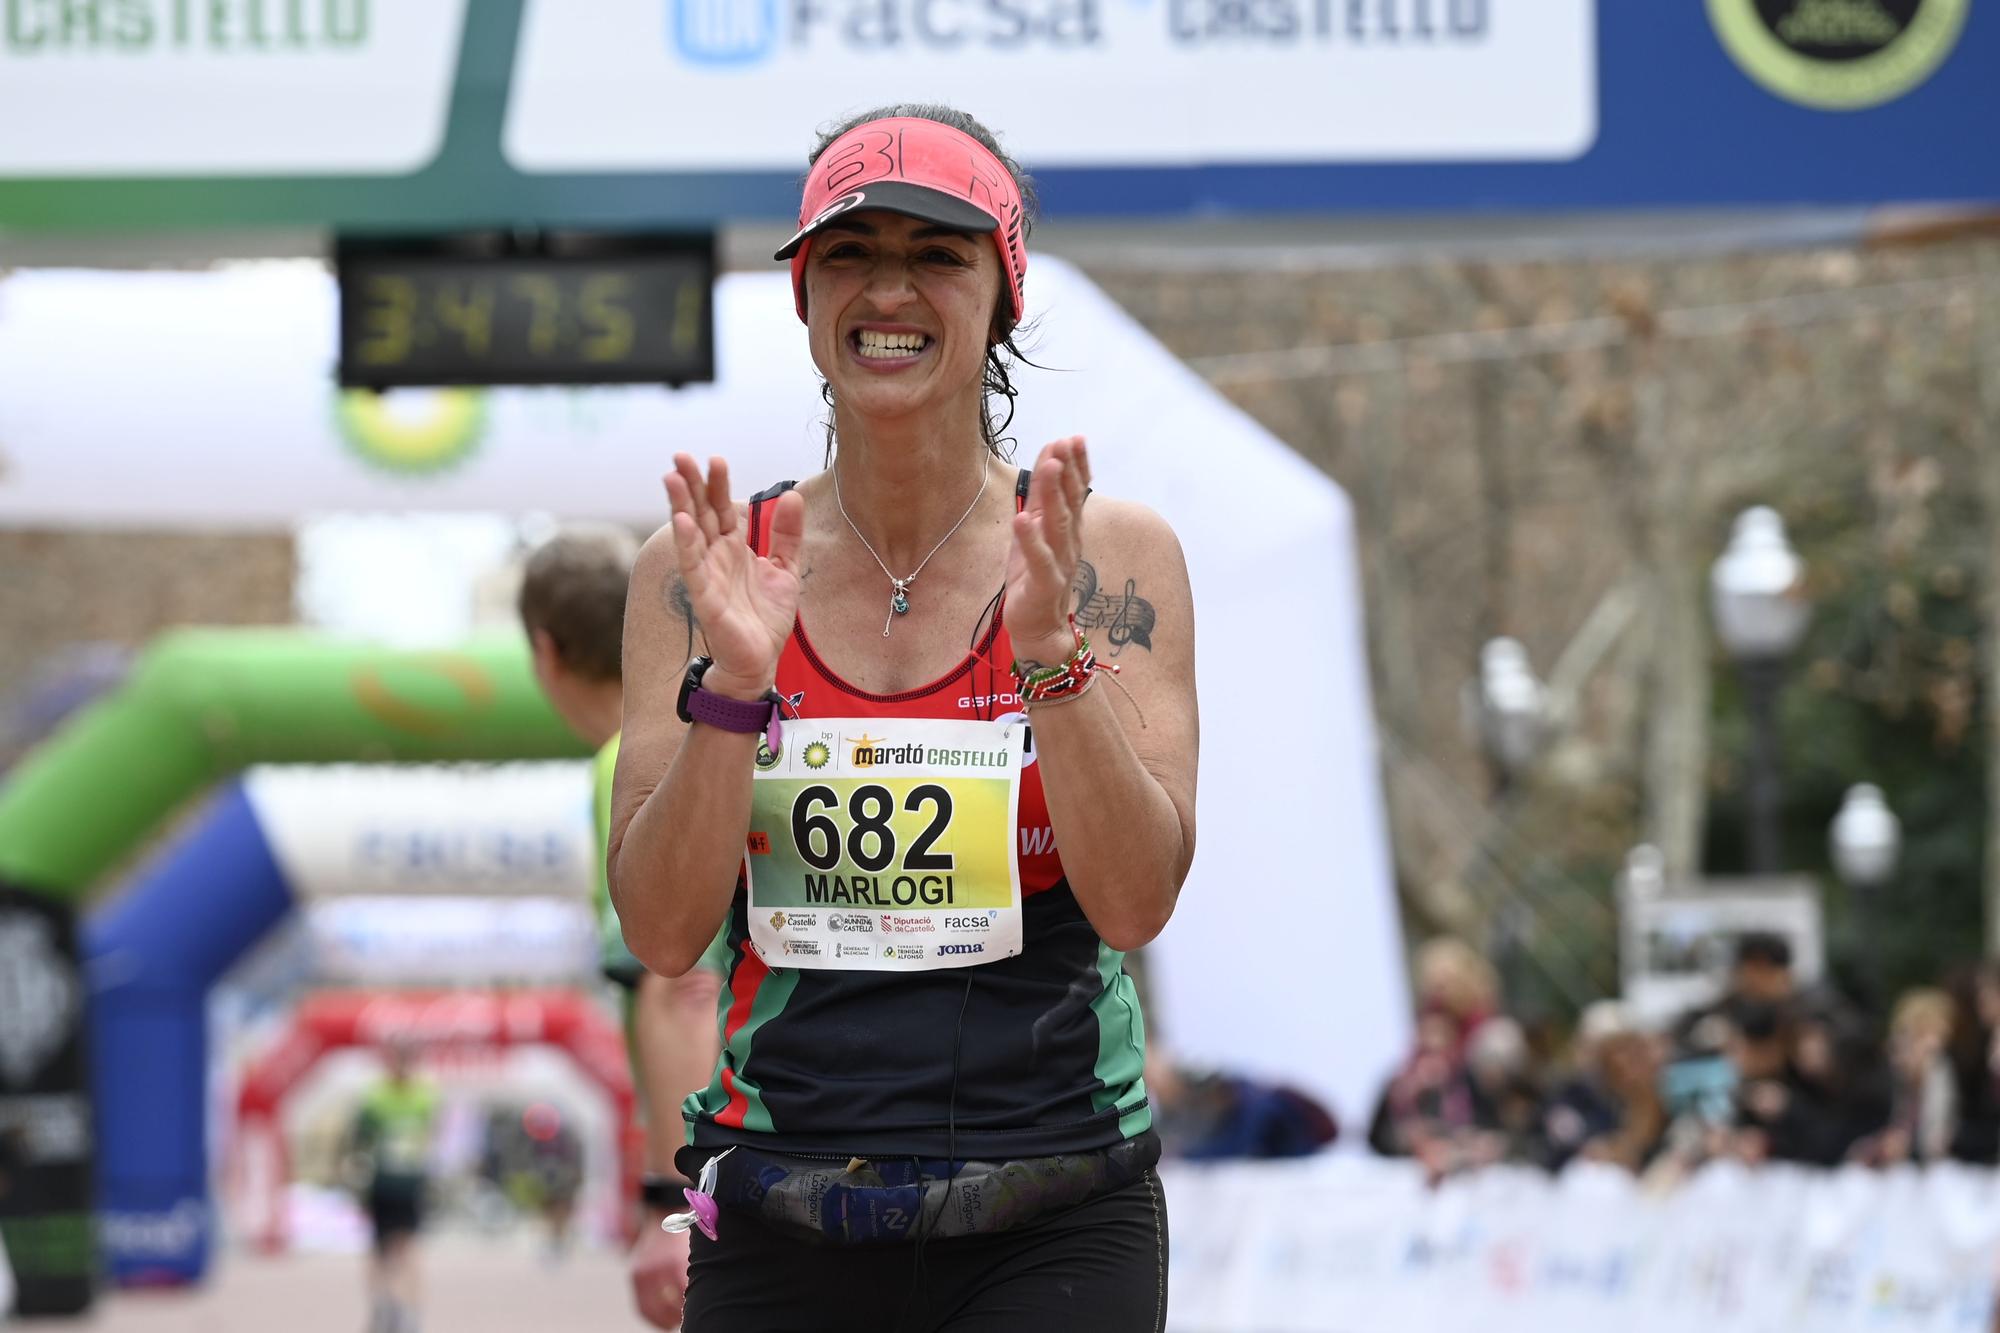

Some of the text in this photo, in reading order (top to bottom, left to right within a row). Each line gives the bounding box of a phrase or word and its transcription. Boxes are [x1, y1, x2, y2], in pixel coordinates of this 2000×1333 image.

[821, 731, 833, 740] bp
[855, 744, 1008, 767] marató CASTELLÓ
[791, 784, 954, 872] 682
[804, 874, 954, 906] MARLOGI
[787, 917, 817, 927] Castelló
[894, 917, 931, 925] Diputació
[944, 916, 990, 928] Facsa
[807, 1174, 820, 1224] Longovit
